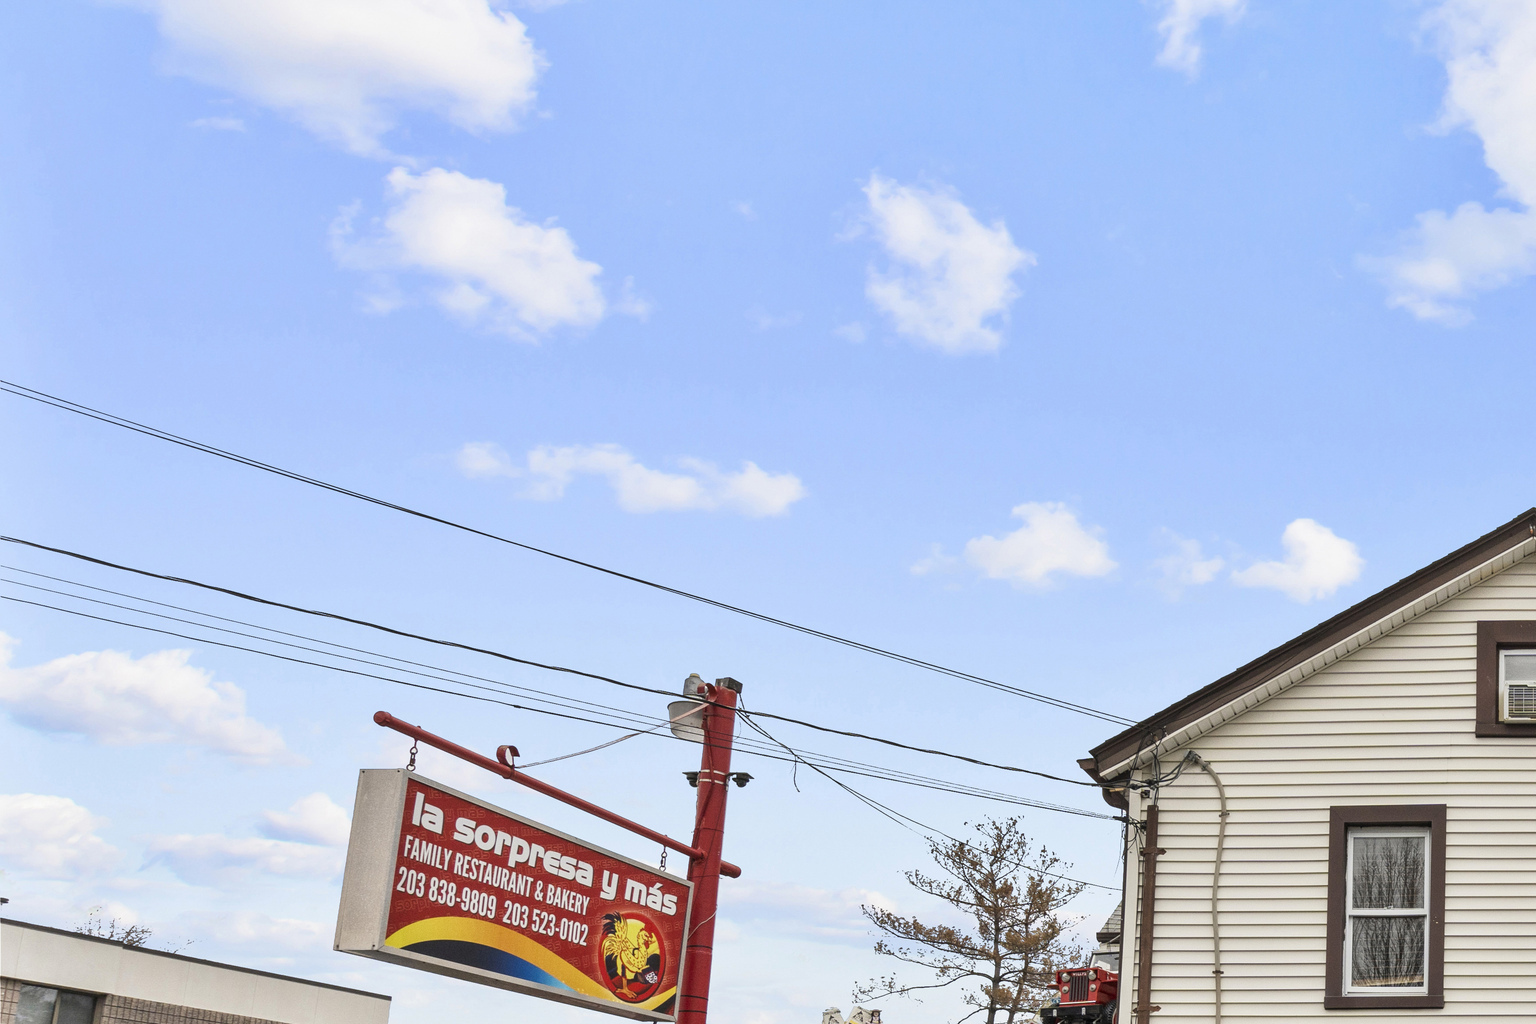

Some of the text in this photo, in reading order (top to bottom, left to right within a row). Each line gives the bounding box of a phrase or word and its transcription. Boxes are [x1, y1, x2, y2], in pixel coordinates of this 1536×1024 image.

[403, 834, 590, 916] FAMILY RESTAURANT & BAKERY
[412, 791, 678, 916] la sorpresa y más
[396, 866, 589, 946] 203 838-9809 203 523-0102
